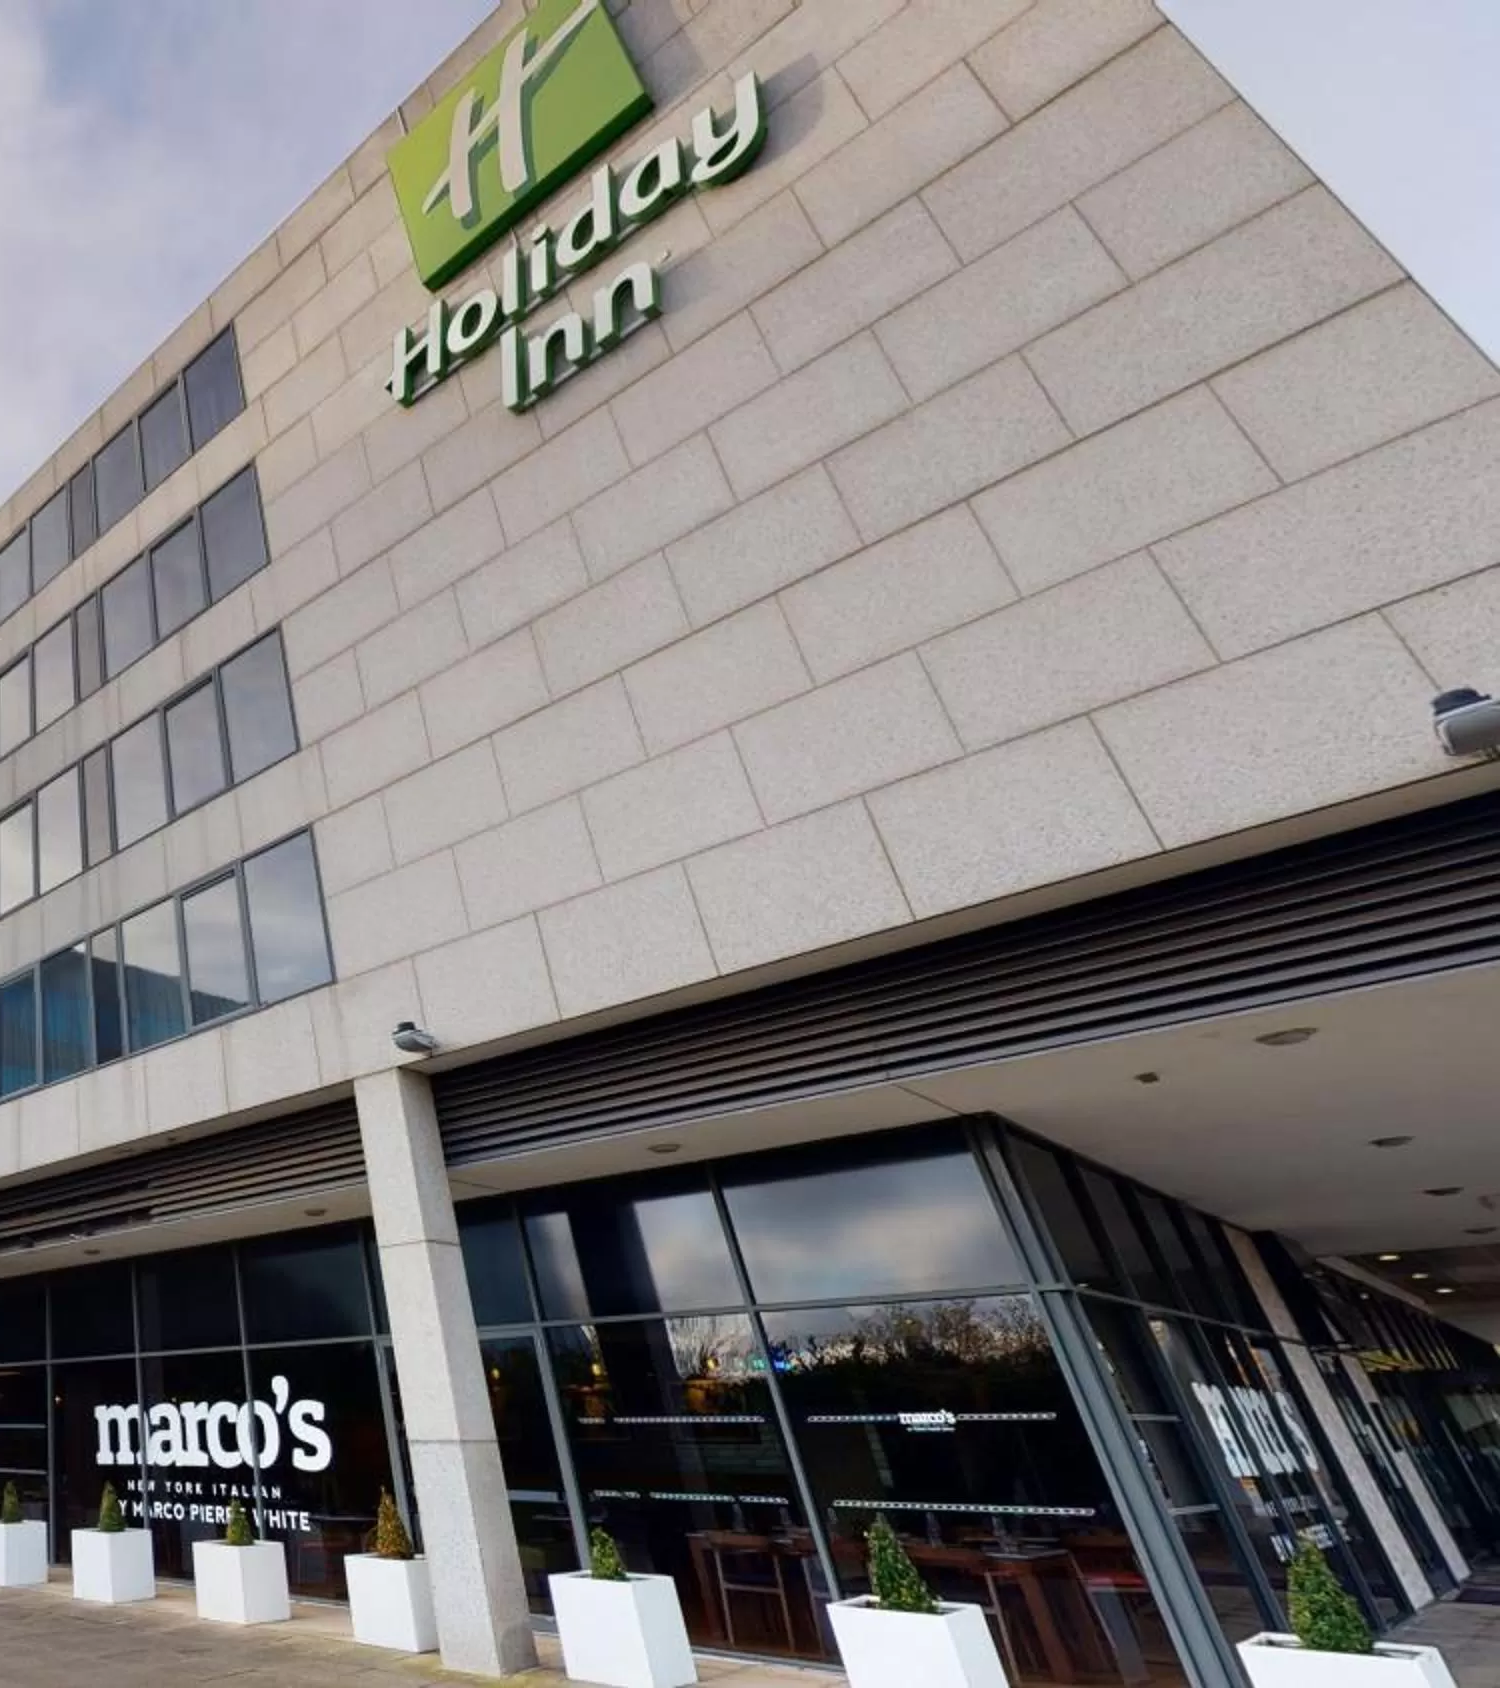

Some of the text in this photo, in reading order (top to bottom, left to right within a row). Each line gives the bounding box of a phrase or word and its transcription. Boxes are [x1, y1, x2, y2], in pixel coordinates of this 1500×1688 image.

[385, 70, 765, 406] Holiday
[500, 260, 661, 413] Inn
[93, 1375, 333, 1473] marco's
[127, 1479, 282, 1500] NEW YORK ITALIAN
